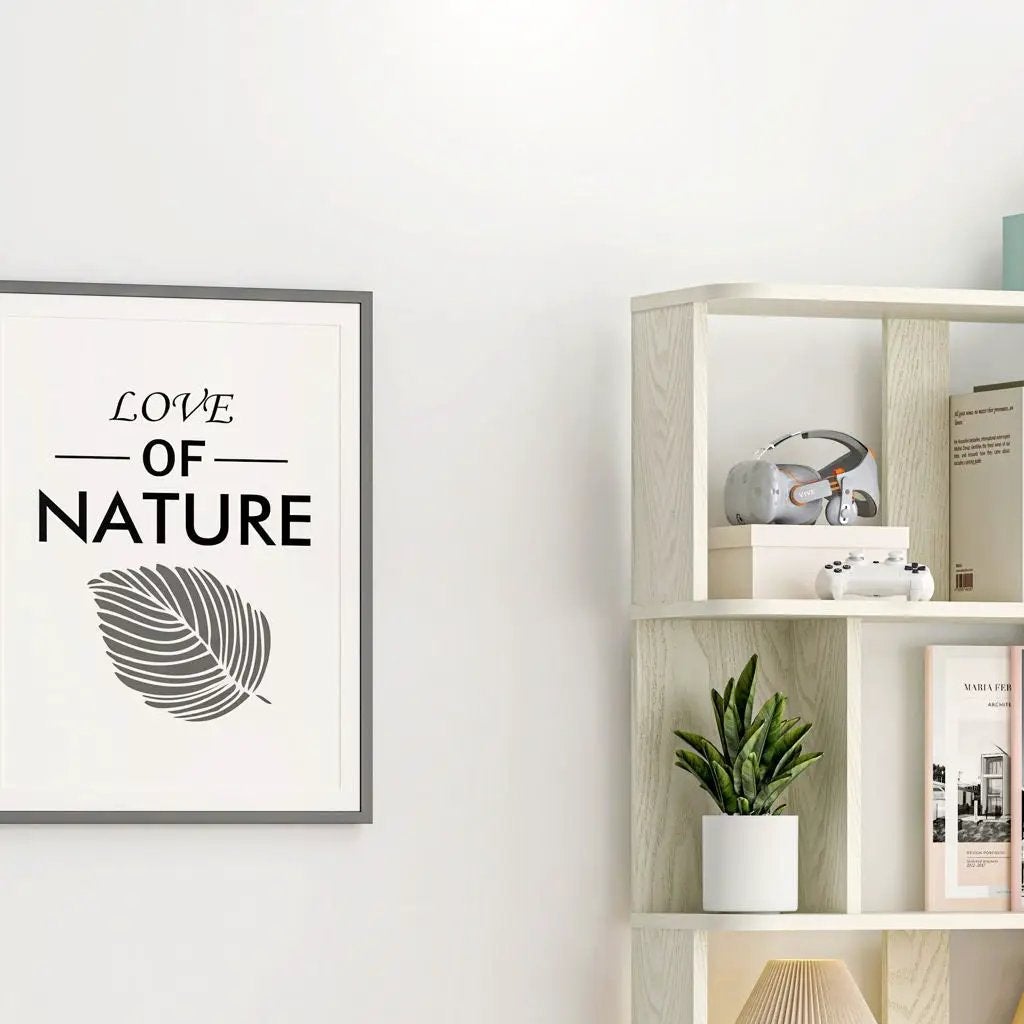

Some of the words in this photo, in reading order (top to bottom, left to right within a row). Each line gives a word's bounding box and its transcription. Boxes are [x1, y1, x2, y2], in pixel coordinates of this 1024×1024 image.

[109, 388, 234, 424] LOVE
[143, 438, 206, 477] OF
[39, 488, 312, 546] NATURE
[964, 683, 993, 691] MARIA
